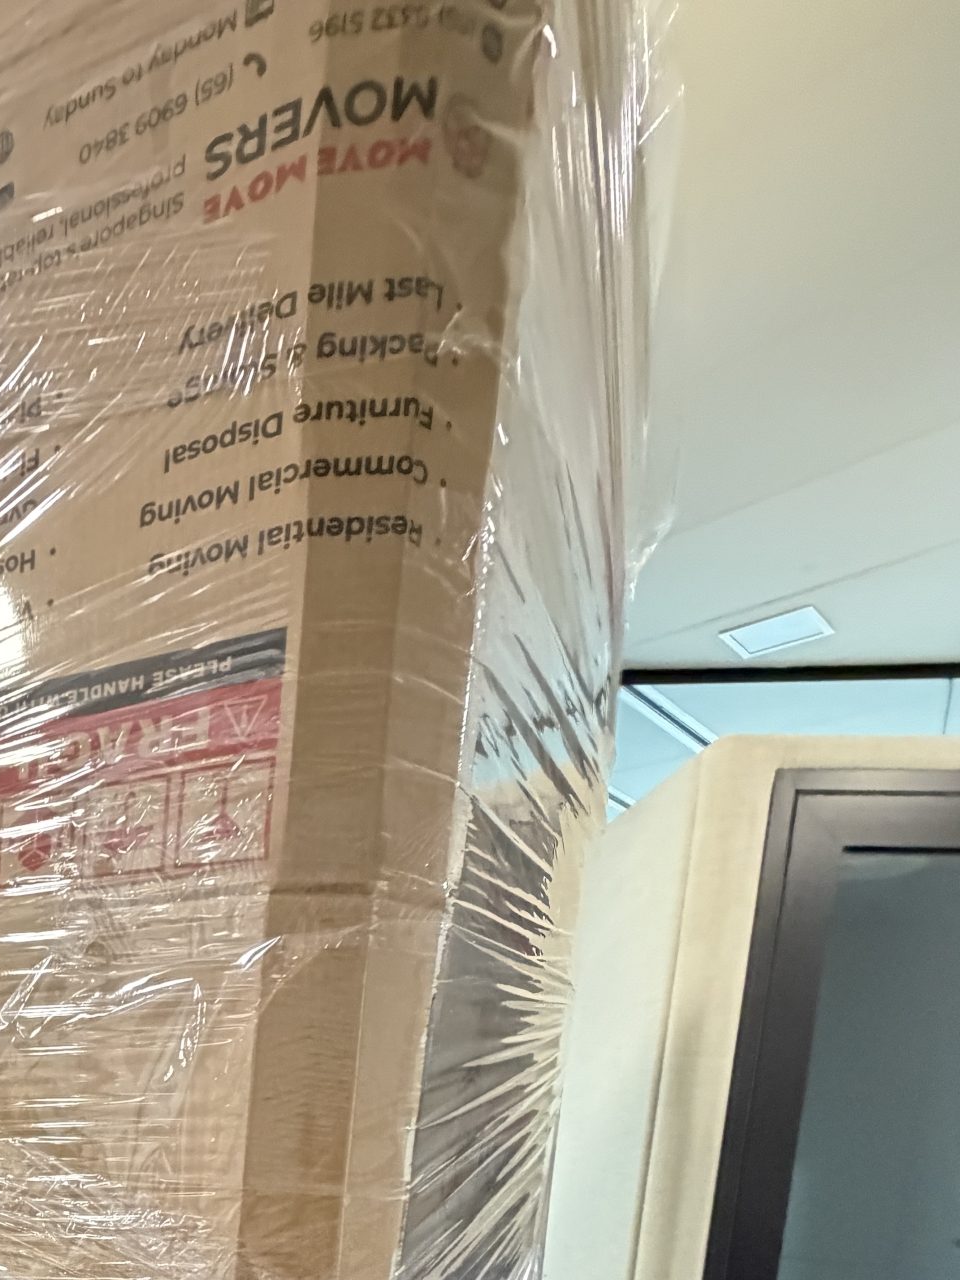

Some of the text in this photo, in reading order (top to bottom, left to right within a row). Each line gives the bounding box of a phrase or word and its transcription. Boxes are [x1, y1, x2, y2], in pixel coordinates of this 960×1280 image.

[43, 10, 237, 130] Monday to Sunday
[78, 63, 233, 165] (65) 6909 3840
[205, 76, 437, 181] MOVERS
[202, 137, 431, 225] MOVE MOVE
[178, 276, 443, 356] Last Mile Delivery
[316, 332, 439, 368] Packing
[163, 397, 434, 474] Furniture Disposal
[139, 455, 428, 530] Commercial Moving
[147, 515, 423, 577] Residential Moving
[60, 674, 144, 703] HANDLE
[152, 656, 232, 689] PLEASE
